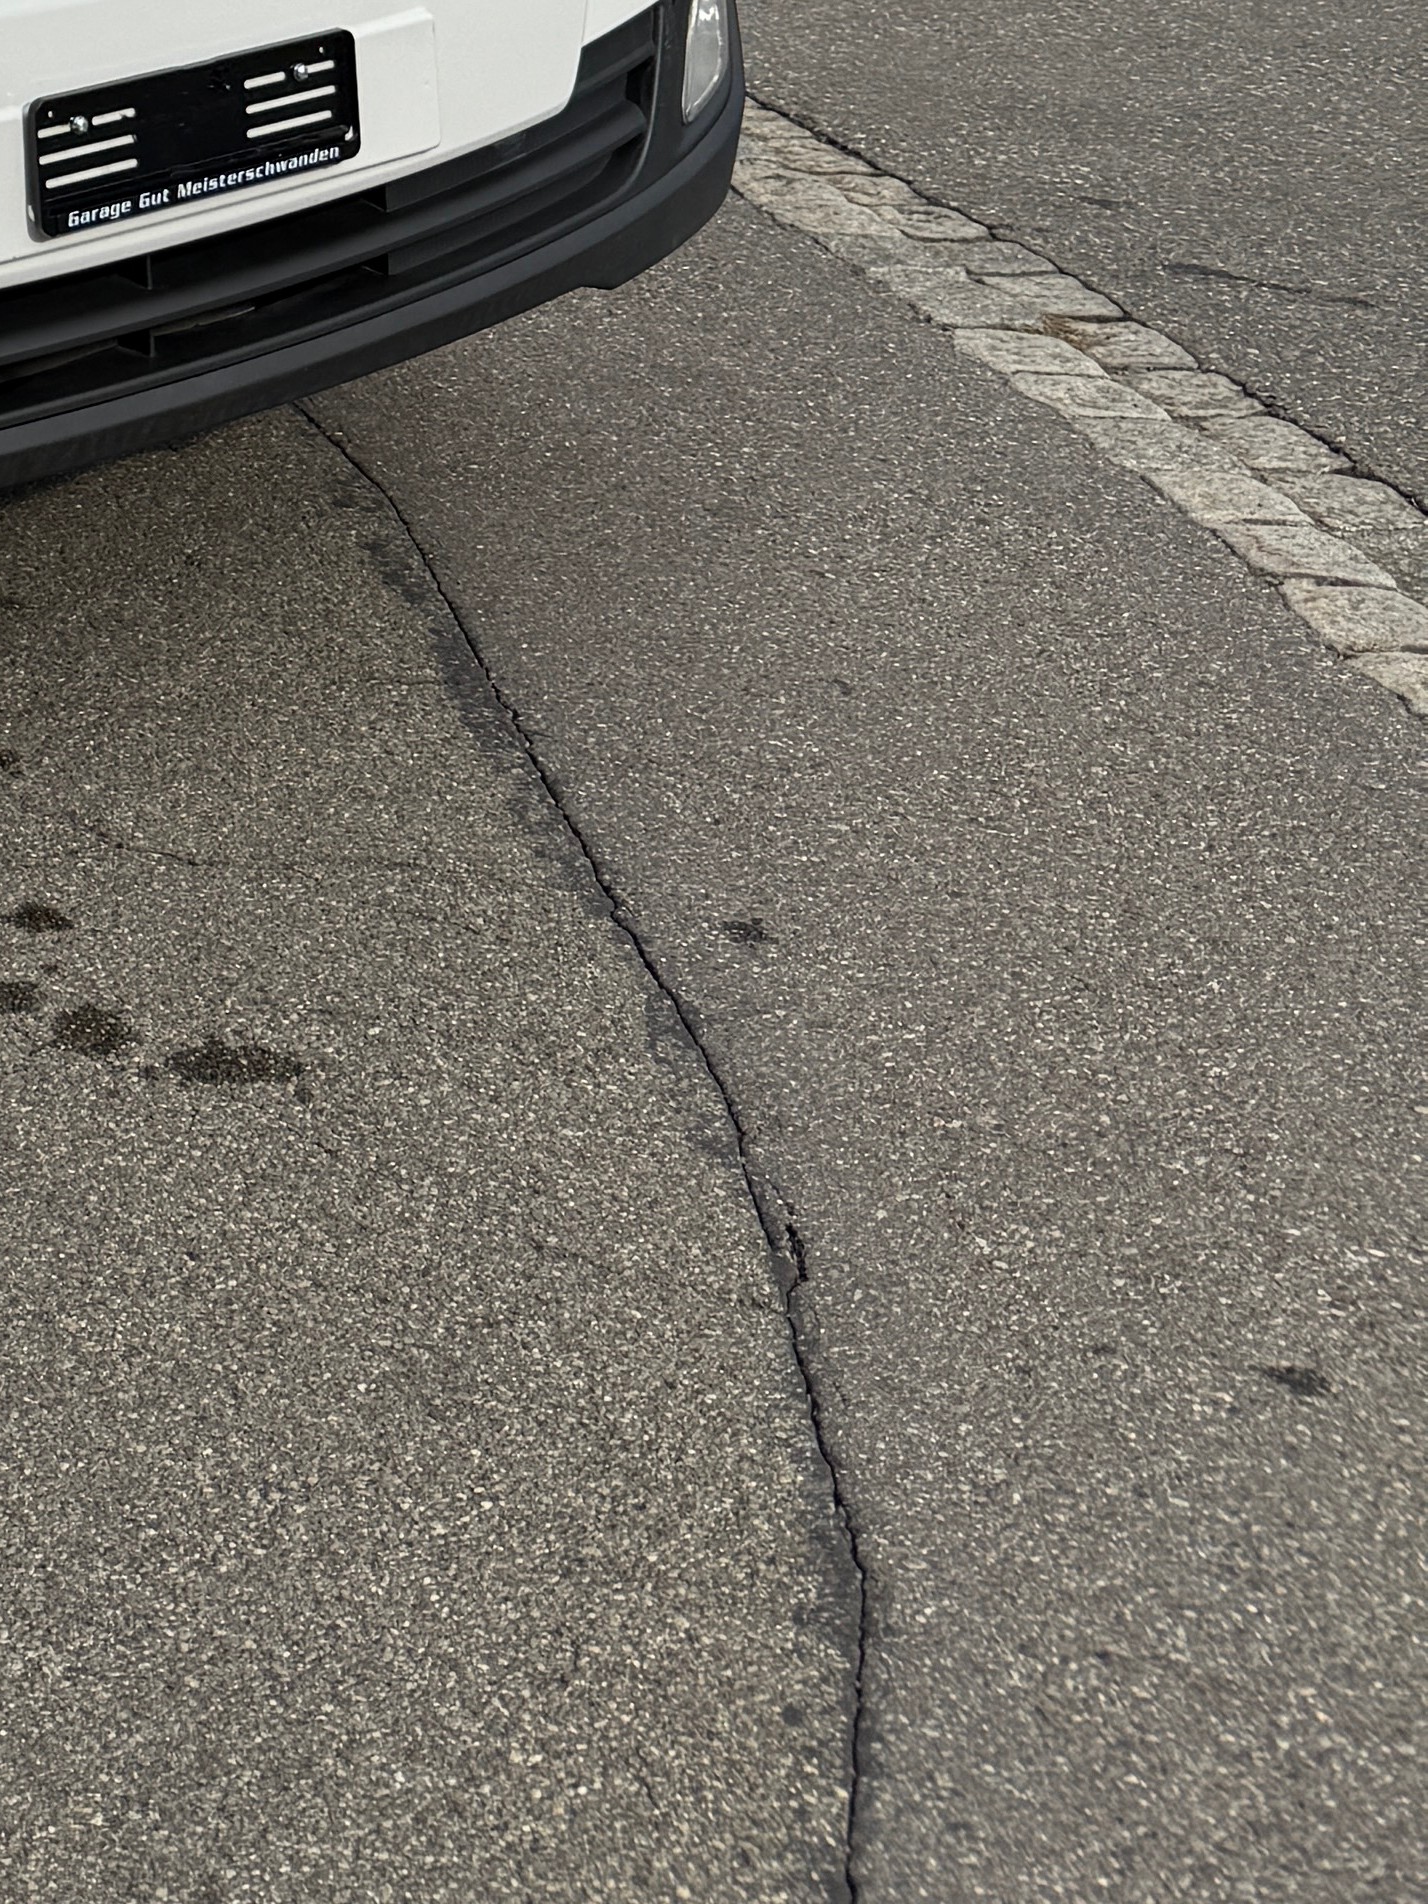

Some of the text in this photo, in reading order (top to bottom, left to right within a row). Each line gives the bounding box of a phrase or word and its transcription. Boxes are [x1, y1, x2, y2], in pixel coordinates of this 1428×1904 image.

[67, 145, 340, 228] Garage Gut Meisterschwanden
